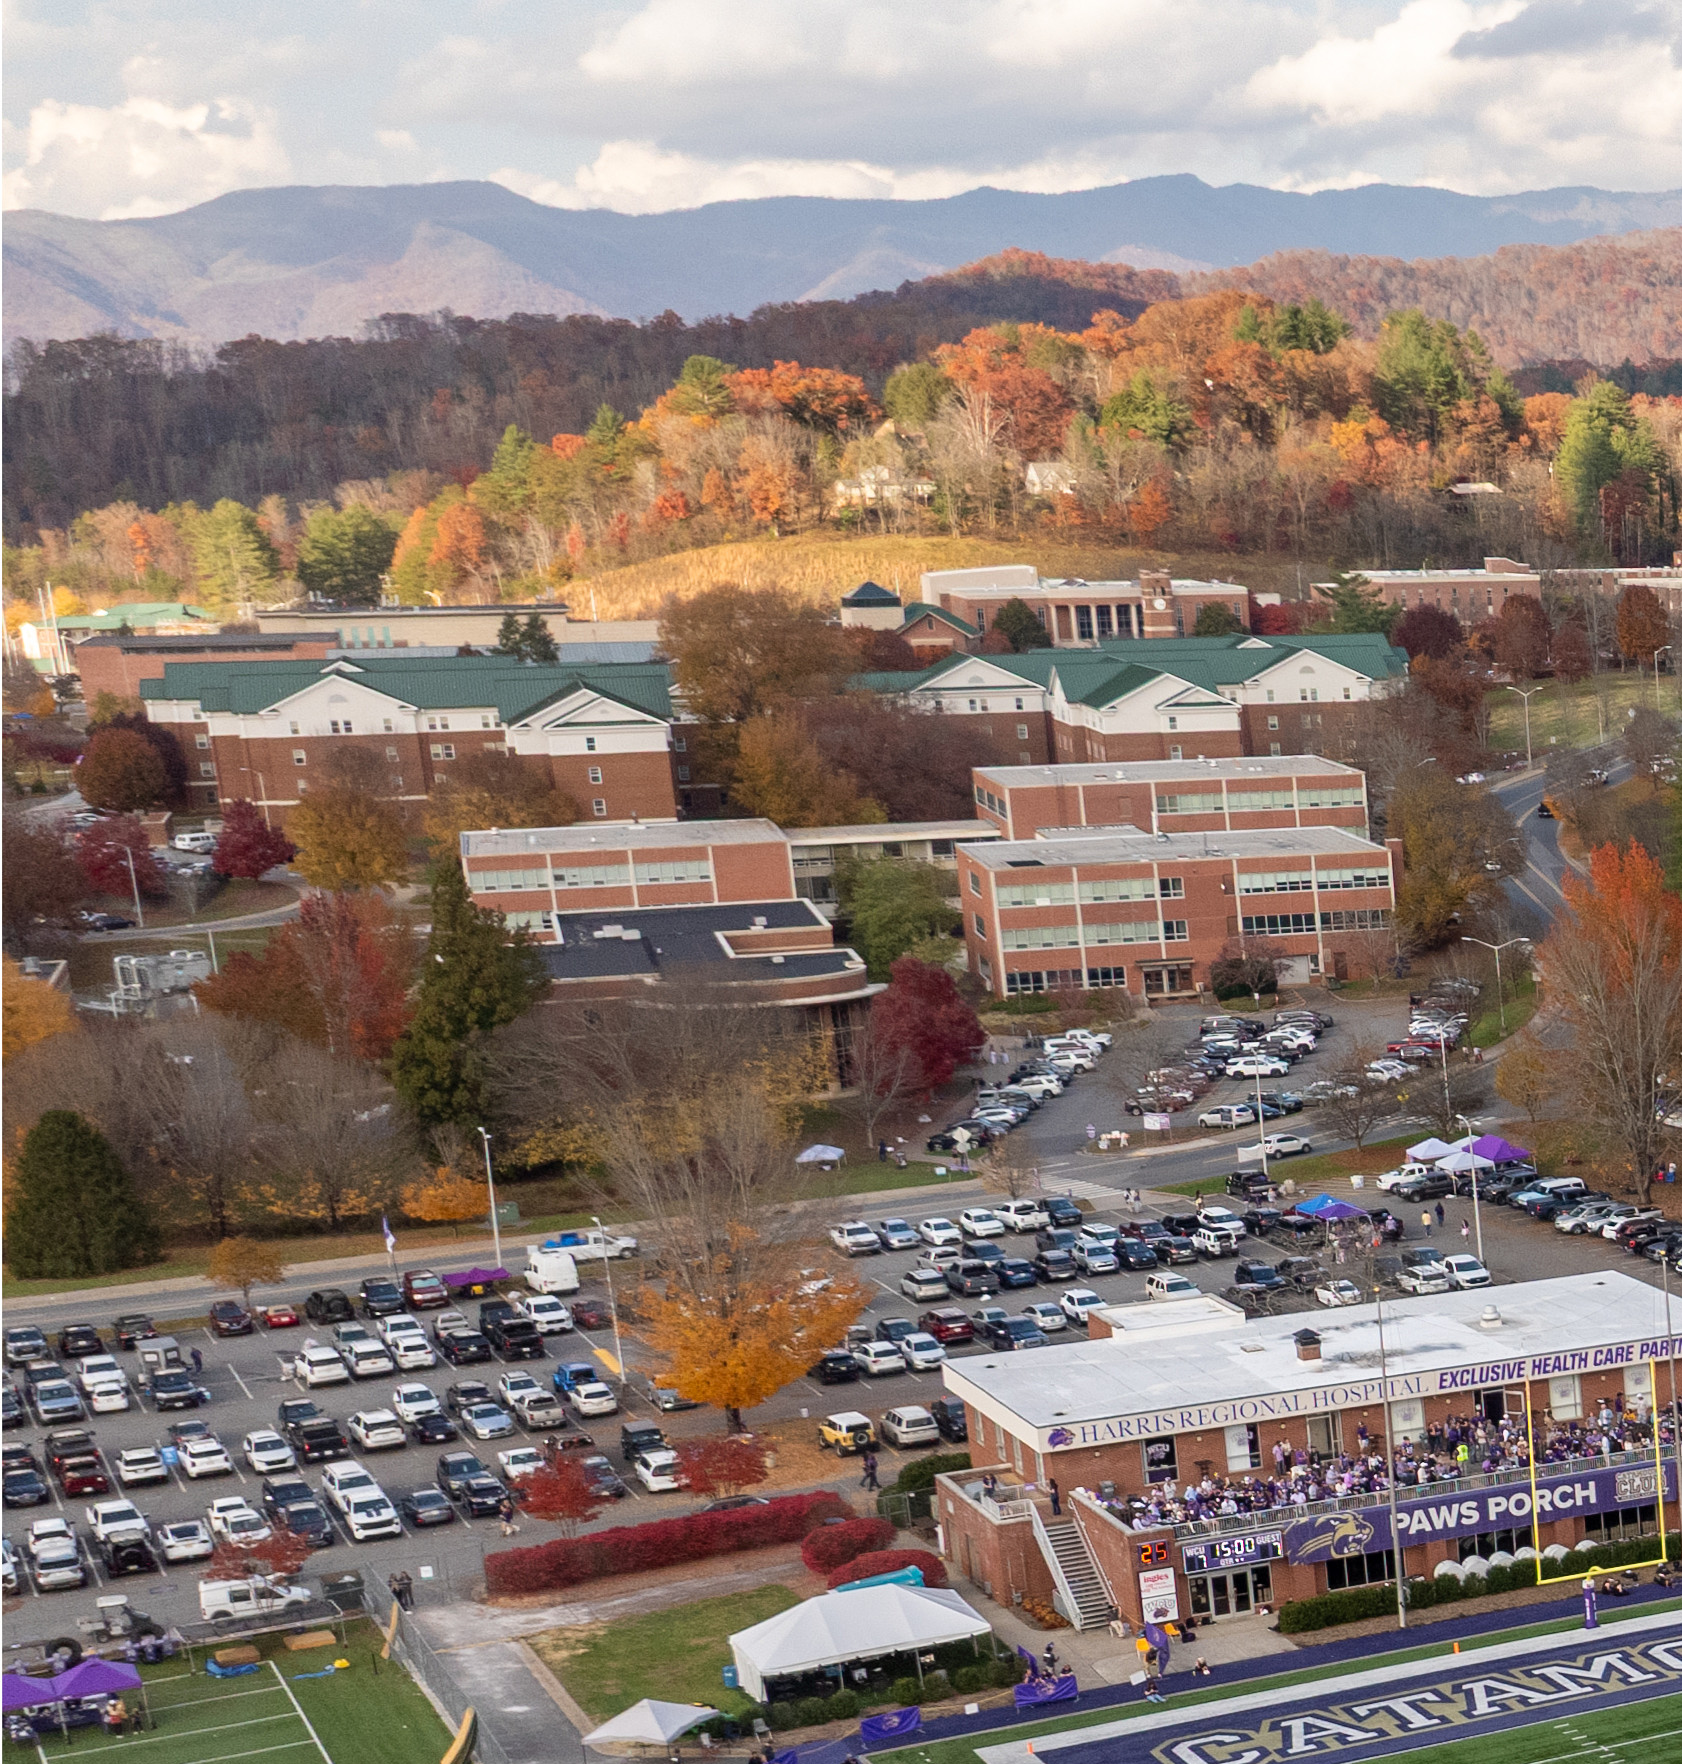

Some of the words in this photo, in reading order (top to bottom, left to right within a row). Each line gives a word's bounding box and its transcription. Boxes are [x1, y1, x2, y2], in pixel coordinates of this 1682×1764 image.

[1080, 1413, 1176, 1444] HARRIS
[1179, 1394, 1310, 1429] REGIONAL
[1312, 1376, 1430, 1409] HOSPITAL
[1438, 1360, 1527, 1390] EXCLUSIVE
[1531, 1351, 1588, 1376] HEALTH
[1592, 1344, 1634, 1368] CARE
[1390, 1500, 1480, 1537] PAWS
[1487, 1480, 1597, 1521] PORCH
[1214, 1537, 1256, 1558] 15:00
[1255, 1533, 1281, 1546] GUEST
[1140, 1541, 1168, 1564] 25
[1186, 1545, 1206, 1558] WCU
[1272, 1541, 1282, 1557] 7
[1197, 1555, 1208, 1569] 7
[1143, 1572, 1170, 1584] ingles
